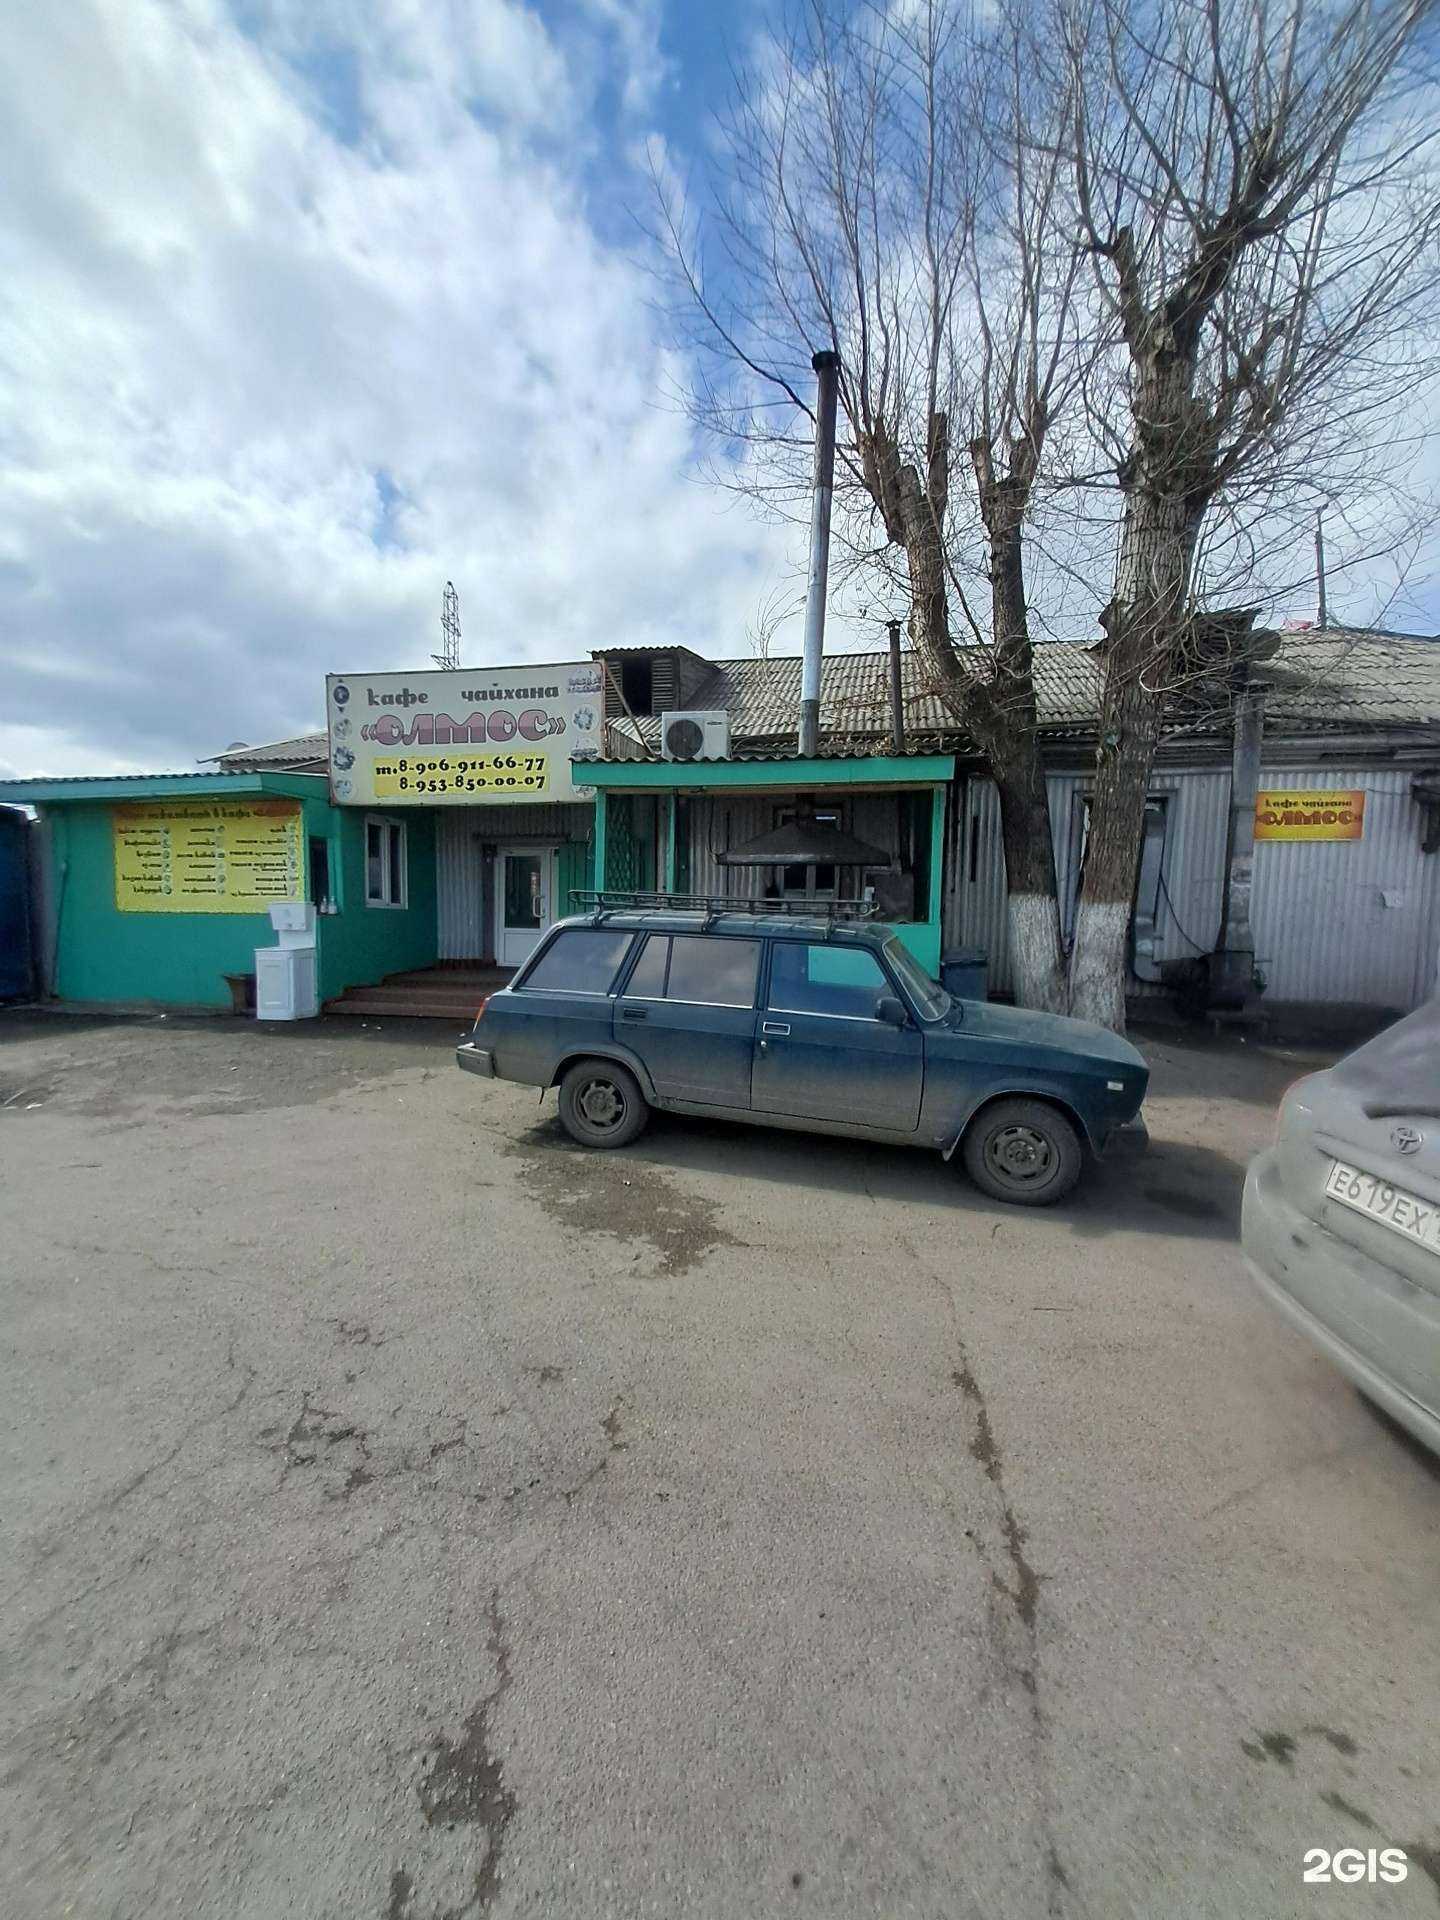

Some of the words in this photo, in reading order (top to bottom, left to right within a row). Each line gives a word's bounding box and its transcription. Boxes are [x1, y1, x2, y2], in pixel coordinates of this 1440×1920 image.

[366, 687, 429, 707] кафе
[460, 683, 560, 702] чайхана
[399, 775, 546, 793] 8-953-850-00-07
